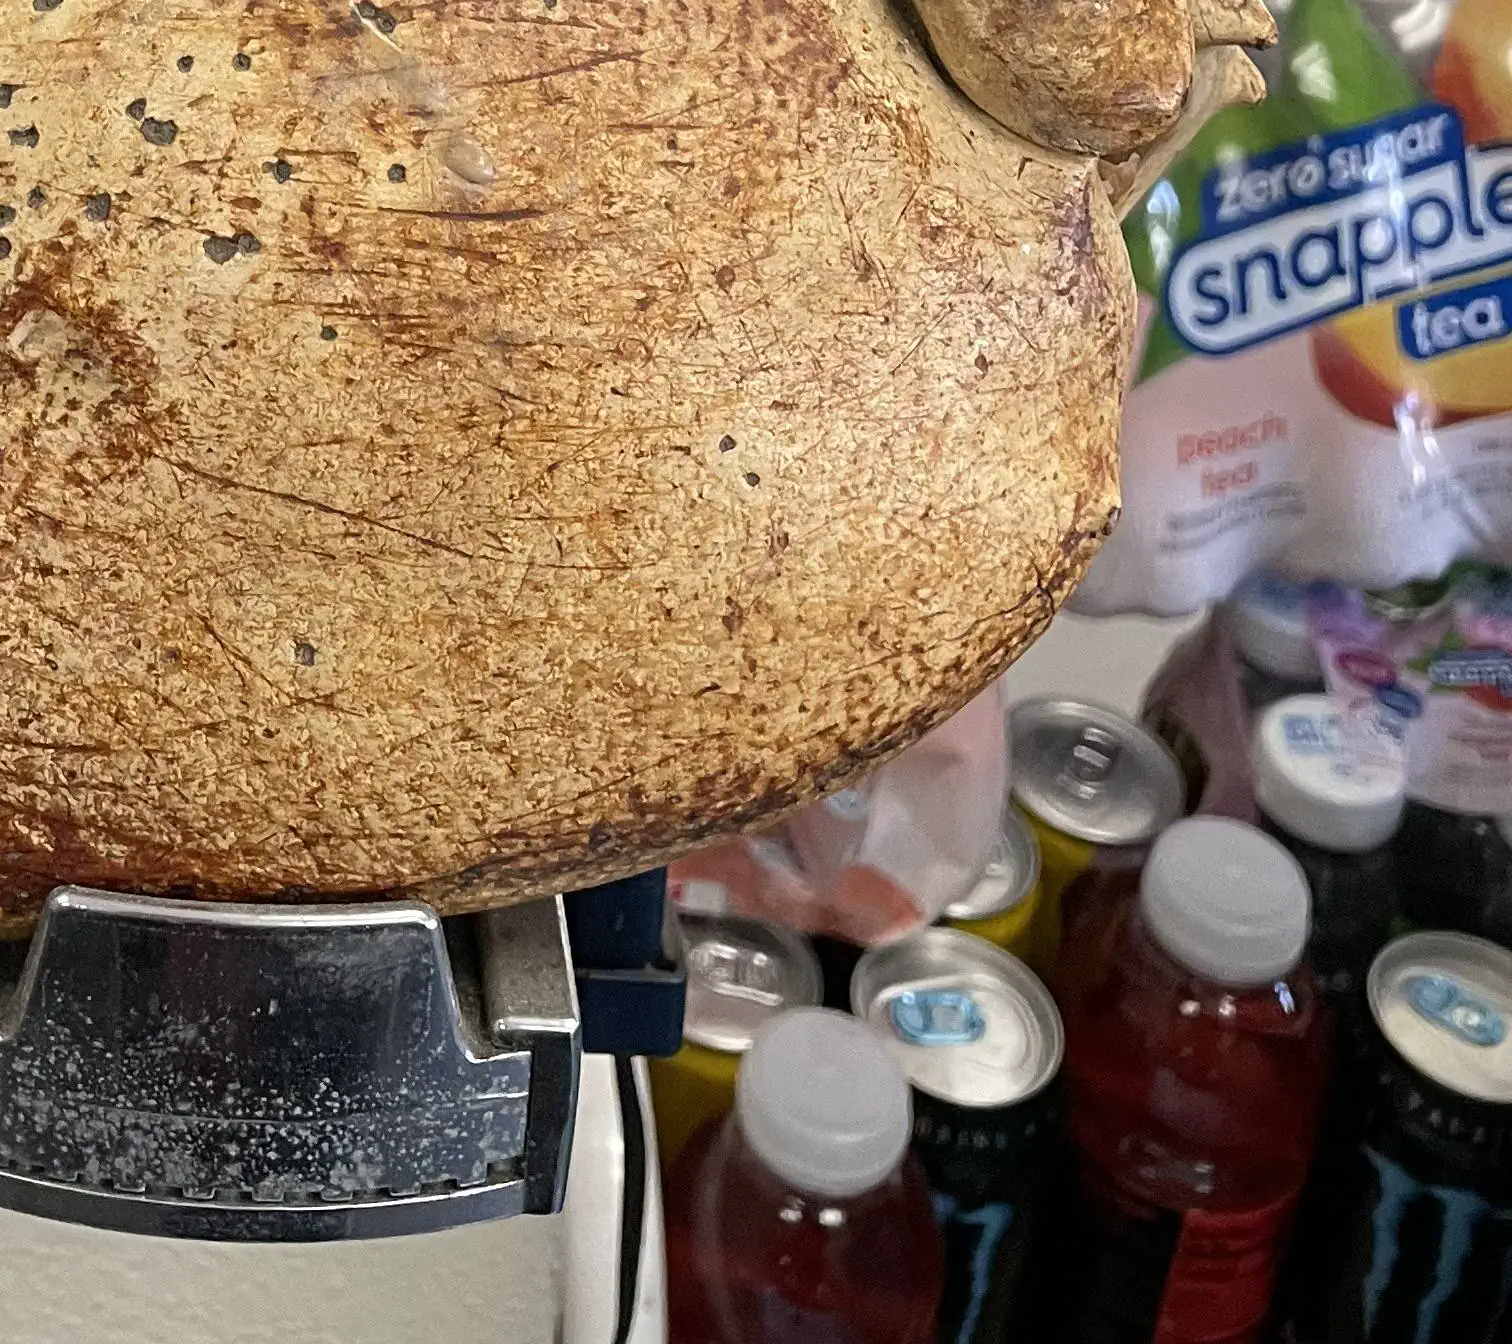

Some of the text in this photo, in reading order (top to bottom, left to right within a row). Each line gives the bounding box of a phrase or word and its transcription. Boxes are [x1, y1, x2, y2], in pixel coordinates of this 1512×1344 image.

[1328, 112, 1450, 192] sugar
[1189, 157, 1512, 327] snapple
[1412, 296, 1507, 356] tea
